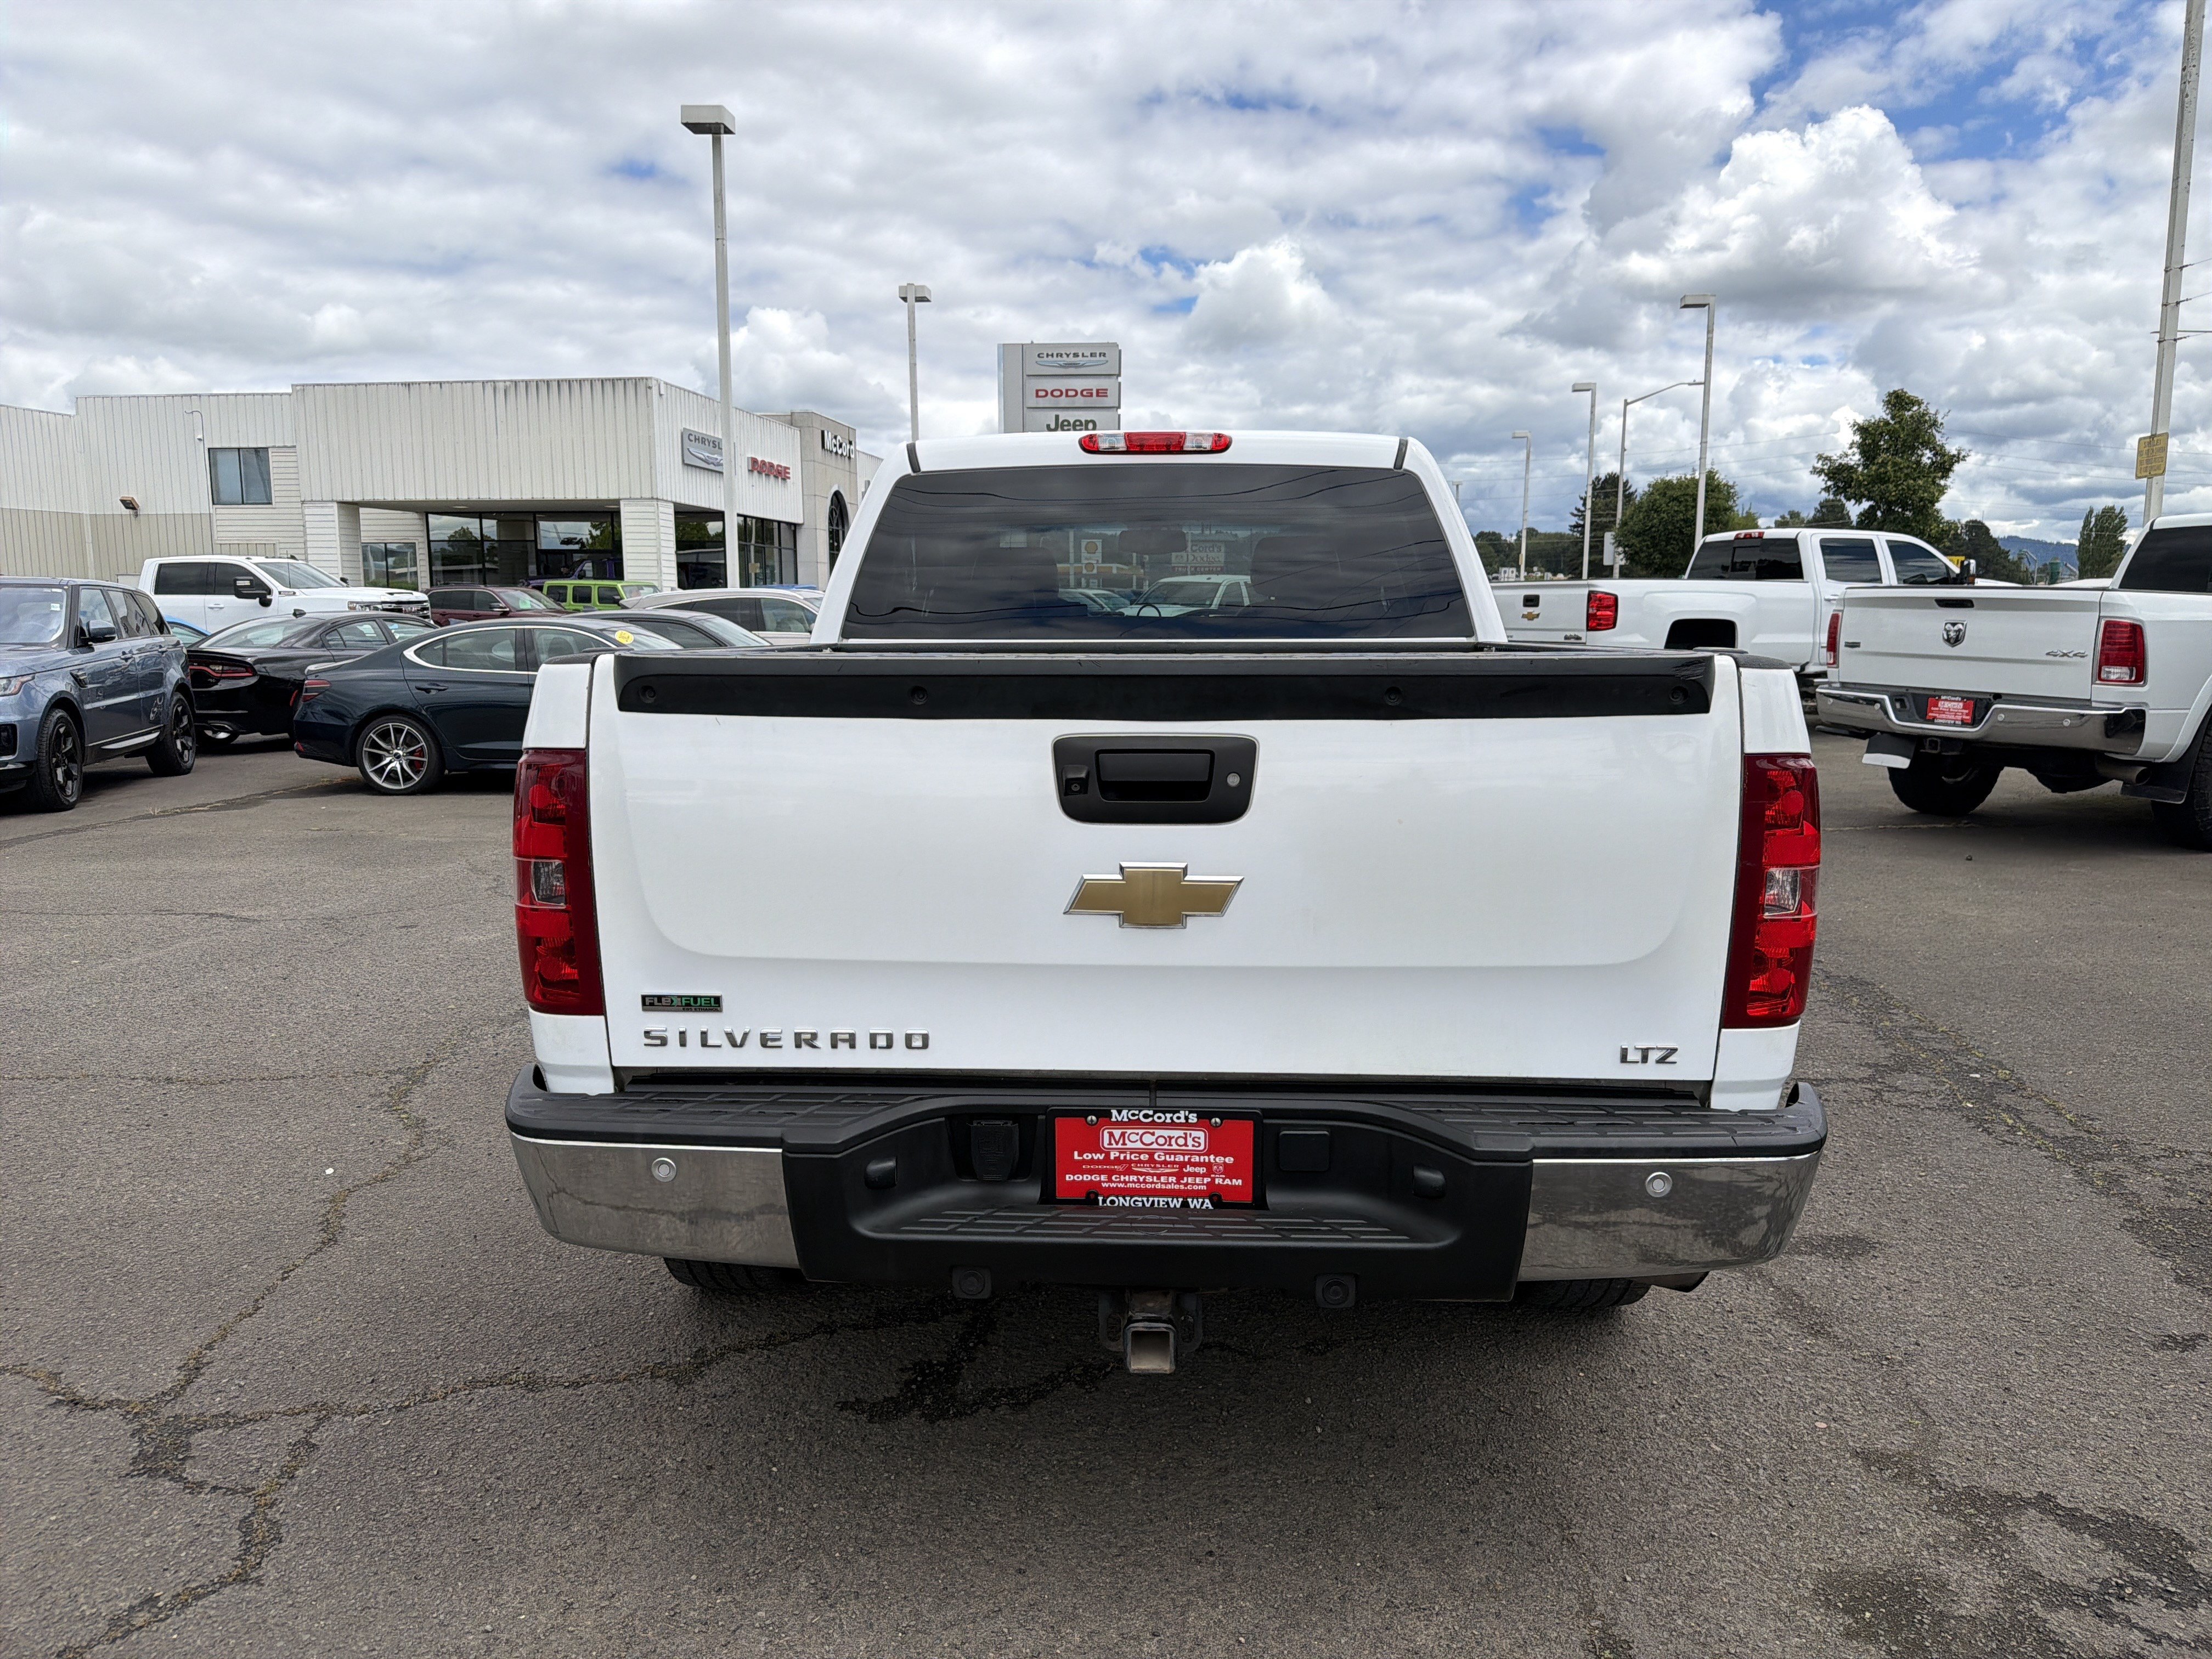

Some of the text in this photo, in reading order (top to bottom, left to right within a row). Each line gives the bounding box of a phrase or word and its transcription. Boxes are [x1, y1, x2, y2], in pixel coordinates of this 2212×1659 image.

[1035, 388, 1109, 398] DODGE
[1046, 414, 1097, 432] Jeep
[687, 433, 723, 450] CHRYSL
[750, 456, 791, 480] DODGE
[644, 1026, 930, 1049] SILVERADO
[1620, 1045, 1678, 1064] LTZ
[1110, 1109, 1198, 1124] McCord's
[1107, 1130, 1202, 1149] McCord's
[1074, 1150, 1234, 1164] Low Price Guarantee
[1183, 1165, 1206, 1174] Jeep
[1101, 1182, 1207, 1190] www.mccordsales.com
[1111, 1175, 1177, 1183] CHRYSLER
[1215, 1178, 1243, 1186] RAM
[1098, 1196, 1214, 1210] LONGVIEW WA
